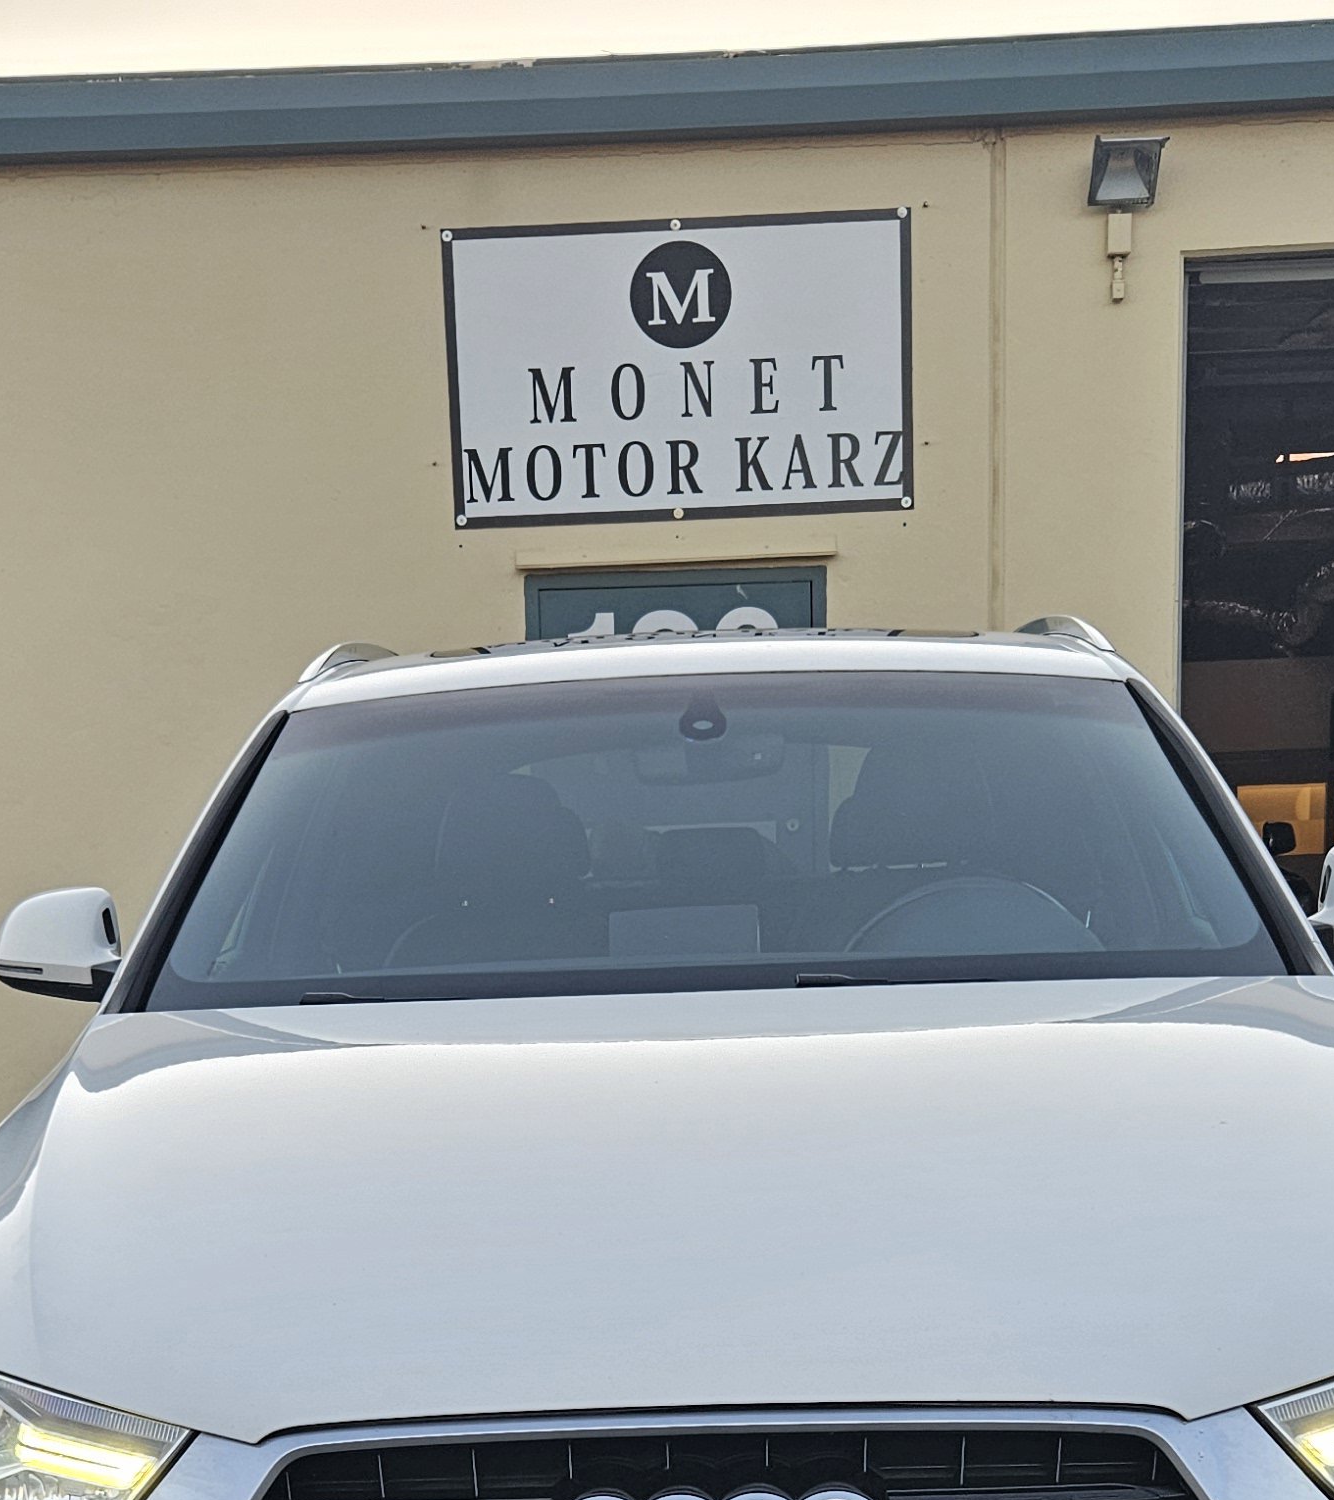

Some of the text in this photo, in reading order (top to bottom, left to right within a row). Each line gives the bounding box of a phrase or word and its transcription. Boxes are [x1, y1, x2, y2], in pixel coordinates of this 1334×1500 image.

[645, 268, 716, 326] M
[527, 354, 845, 425] MONET
[463, 430, 904, 504] MOTOR KARZ
